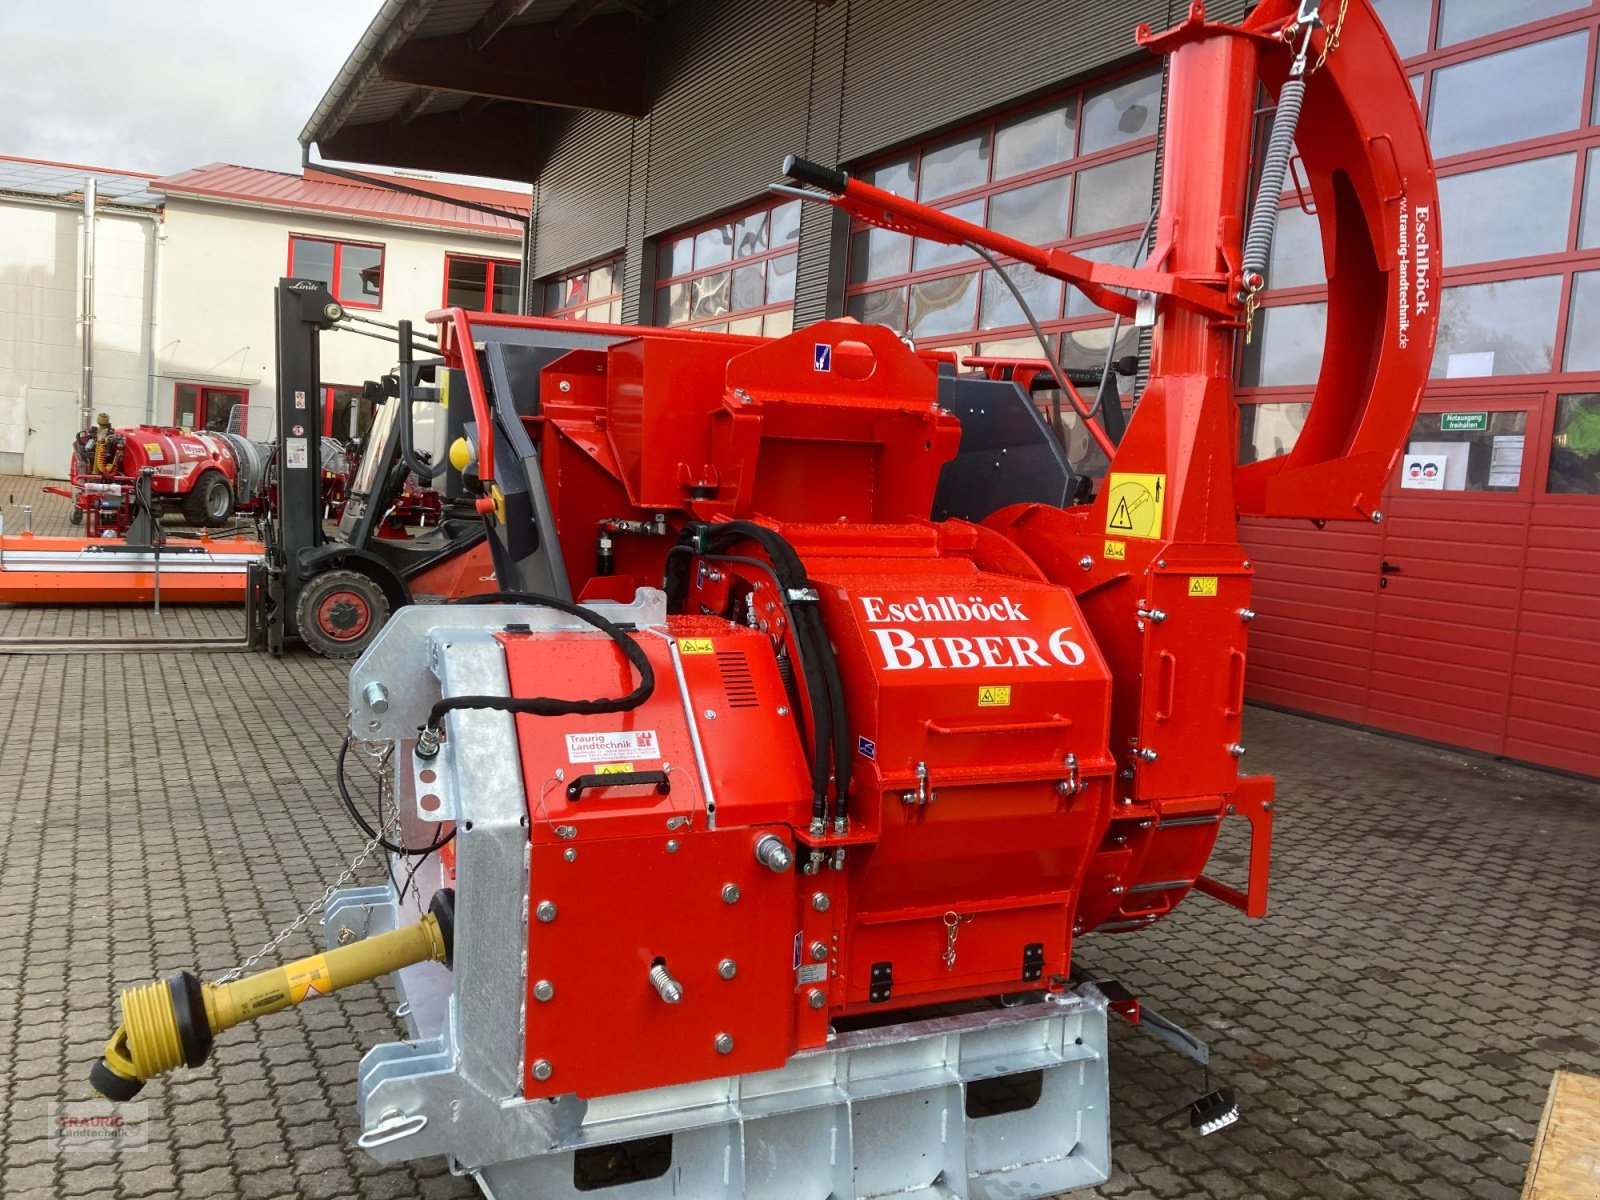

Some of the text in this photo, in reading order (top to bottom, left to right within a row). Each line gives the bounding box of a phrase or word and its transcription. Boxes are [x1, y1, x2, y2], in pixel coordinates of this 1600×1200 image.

[1415, 204, 1430, 317] Eschlböck
[288, 280, 319, 291] Linde
[1446, 414, 1482, 423] Notausgang
[858, 596, 1030, 623] Eschlböck
[868, 626, 1086, 671] BIBER 6
[569, 734, 605, 744] Traurig
[571, 740, 633, 751] Landtechnik
